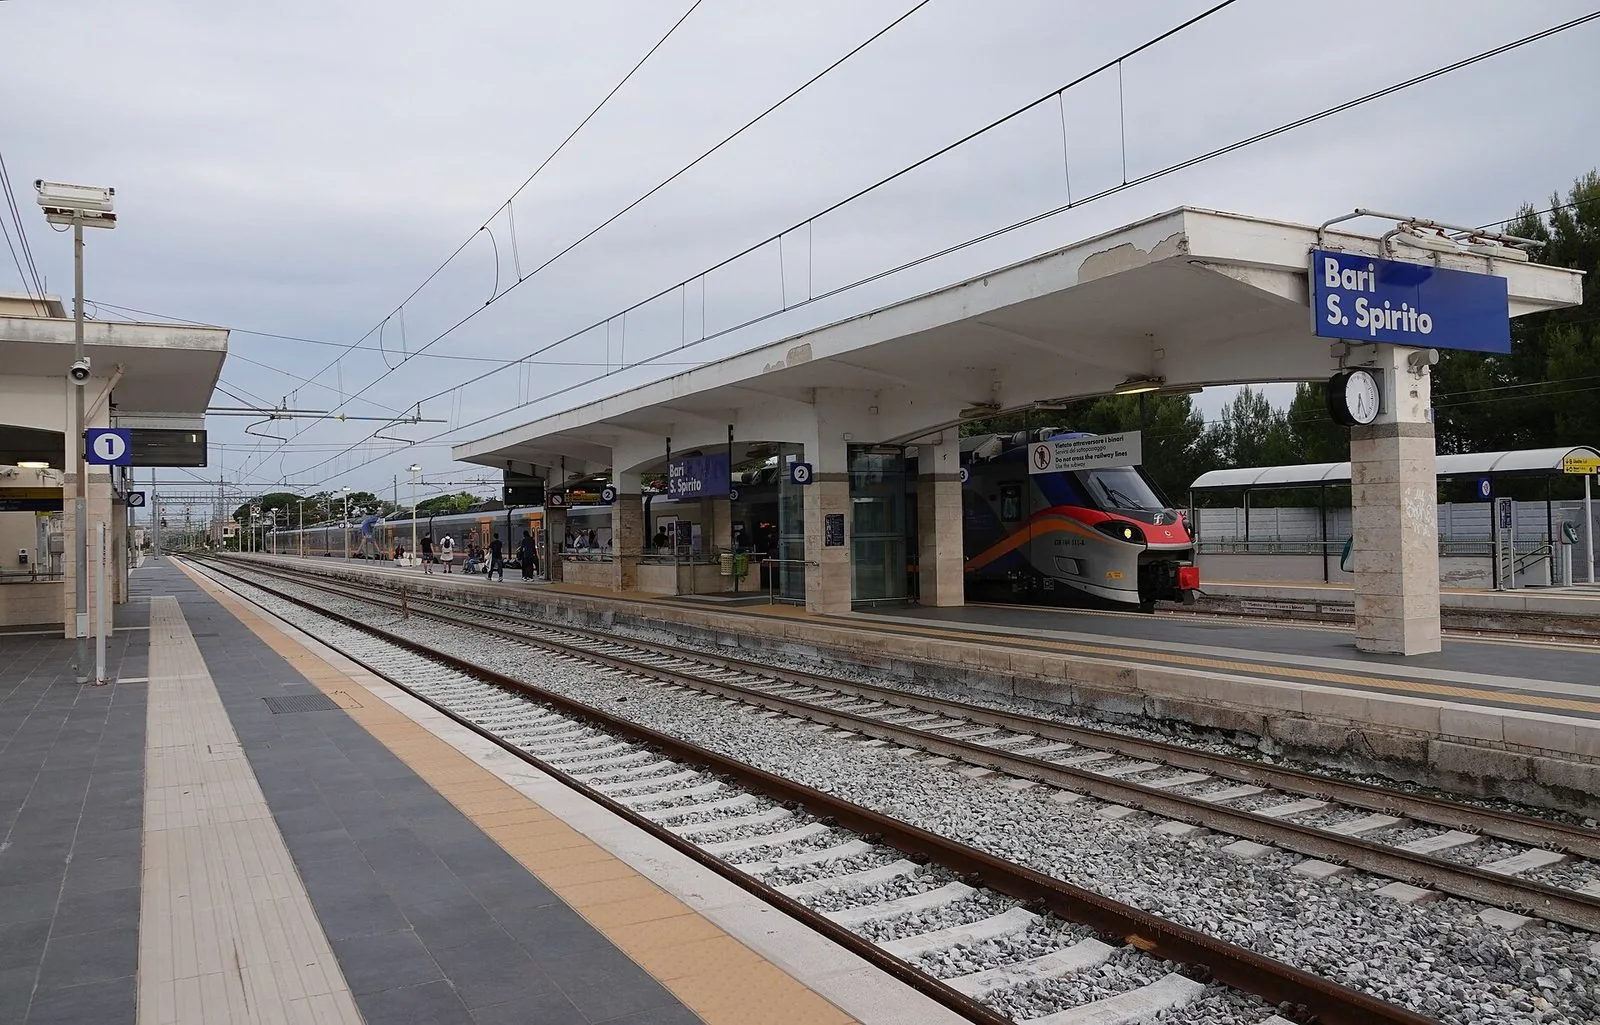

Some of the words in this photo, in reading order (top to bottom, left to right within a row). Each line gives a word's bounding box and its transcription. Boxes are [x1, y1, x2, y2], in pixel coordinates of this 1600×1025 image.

[1324, 257, 1375, 293] Bari
[1326, 293, 1349, 326] S.
[1355, 297, 1433, 336] Spirito
[191, 434, 197, 443] 1
[1073, 438, 1104, 448] attraversare
[1108, 435, 1124, 443] binari
[105, 438, 114, 455] 1
[1094, 452, 1114, 461] railway
[669, 462, 684, 477] Bari
[798, 469, 805, 479] 2
[960, 470, 966, 480] 3
[670, 479, 676, 493] S.
[677, 477, 702, 496] Spirito
